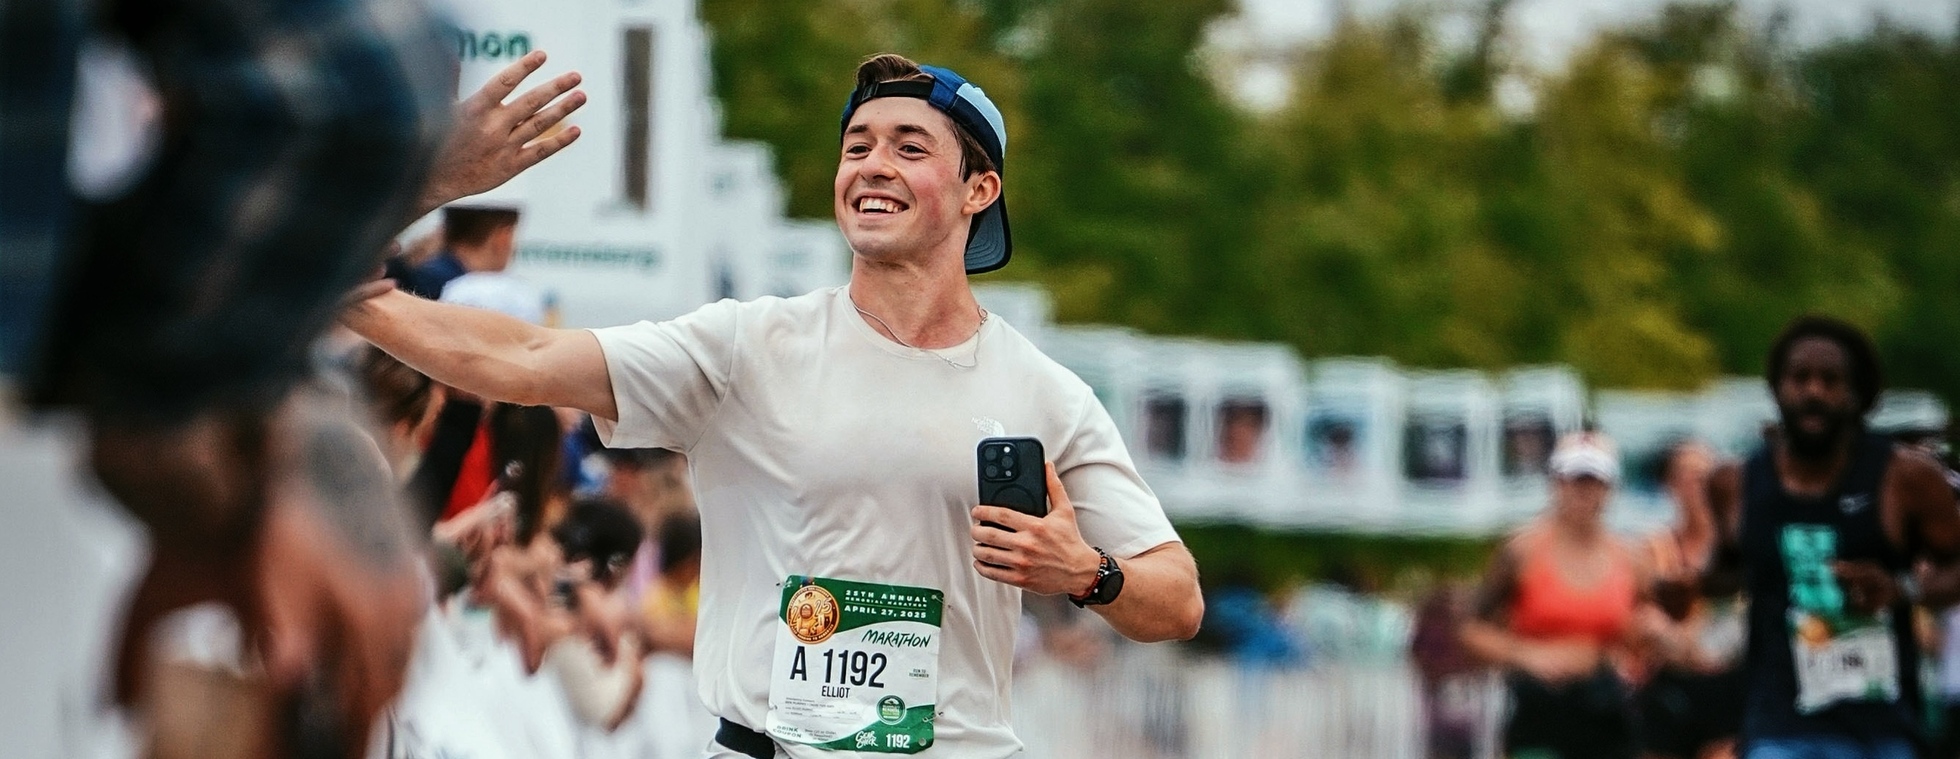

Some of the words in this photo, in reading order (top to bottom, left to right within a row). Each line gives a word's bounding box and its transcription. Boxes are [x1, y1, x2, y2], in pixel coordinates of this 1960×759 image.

[845, 590, 874, 598] 25TH
[881, 593, 927, 603] ANNUAL
[845, 596, 883, 605] MEMORIAL
[844, 605, 877, 614] APRIL
[881, 609, 897, 617] 27,
[900, 610, 926, 619] 2025
[861, 629, 931, 648] MARATHON
[789, 645, 807, 682] A
[823, 648, 887, 688] 1192
[821, 685, 850, 698] ELLIOT
[772, 728, 801, 738] COUPON
[776, 725, 799, 733] DRINK
[886, 733, 910, 749] 1192
